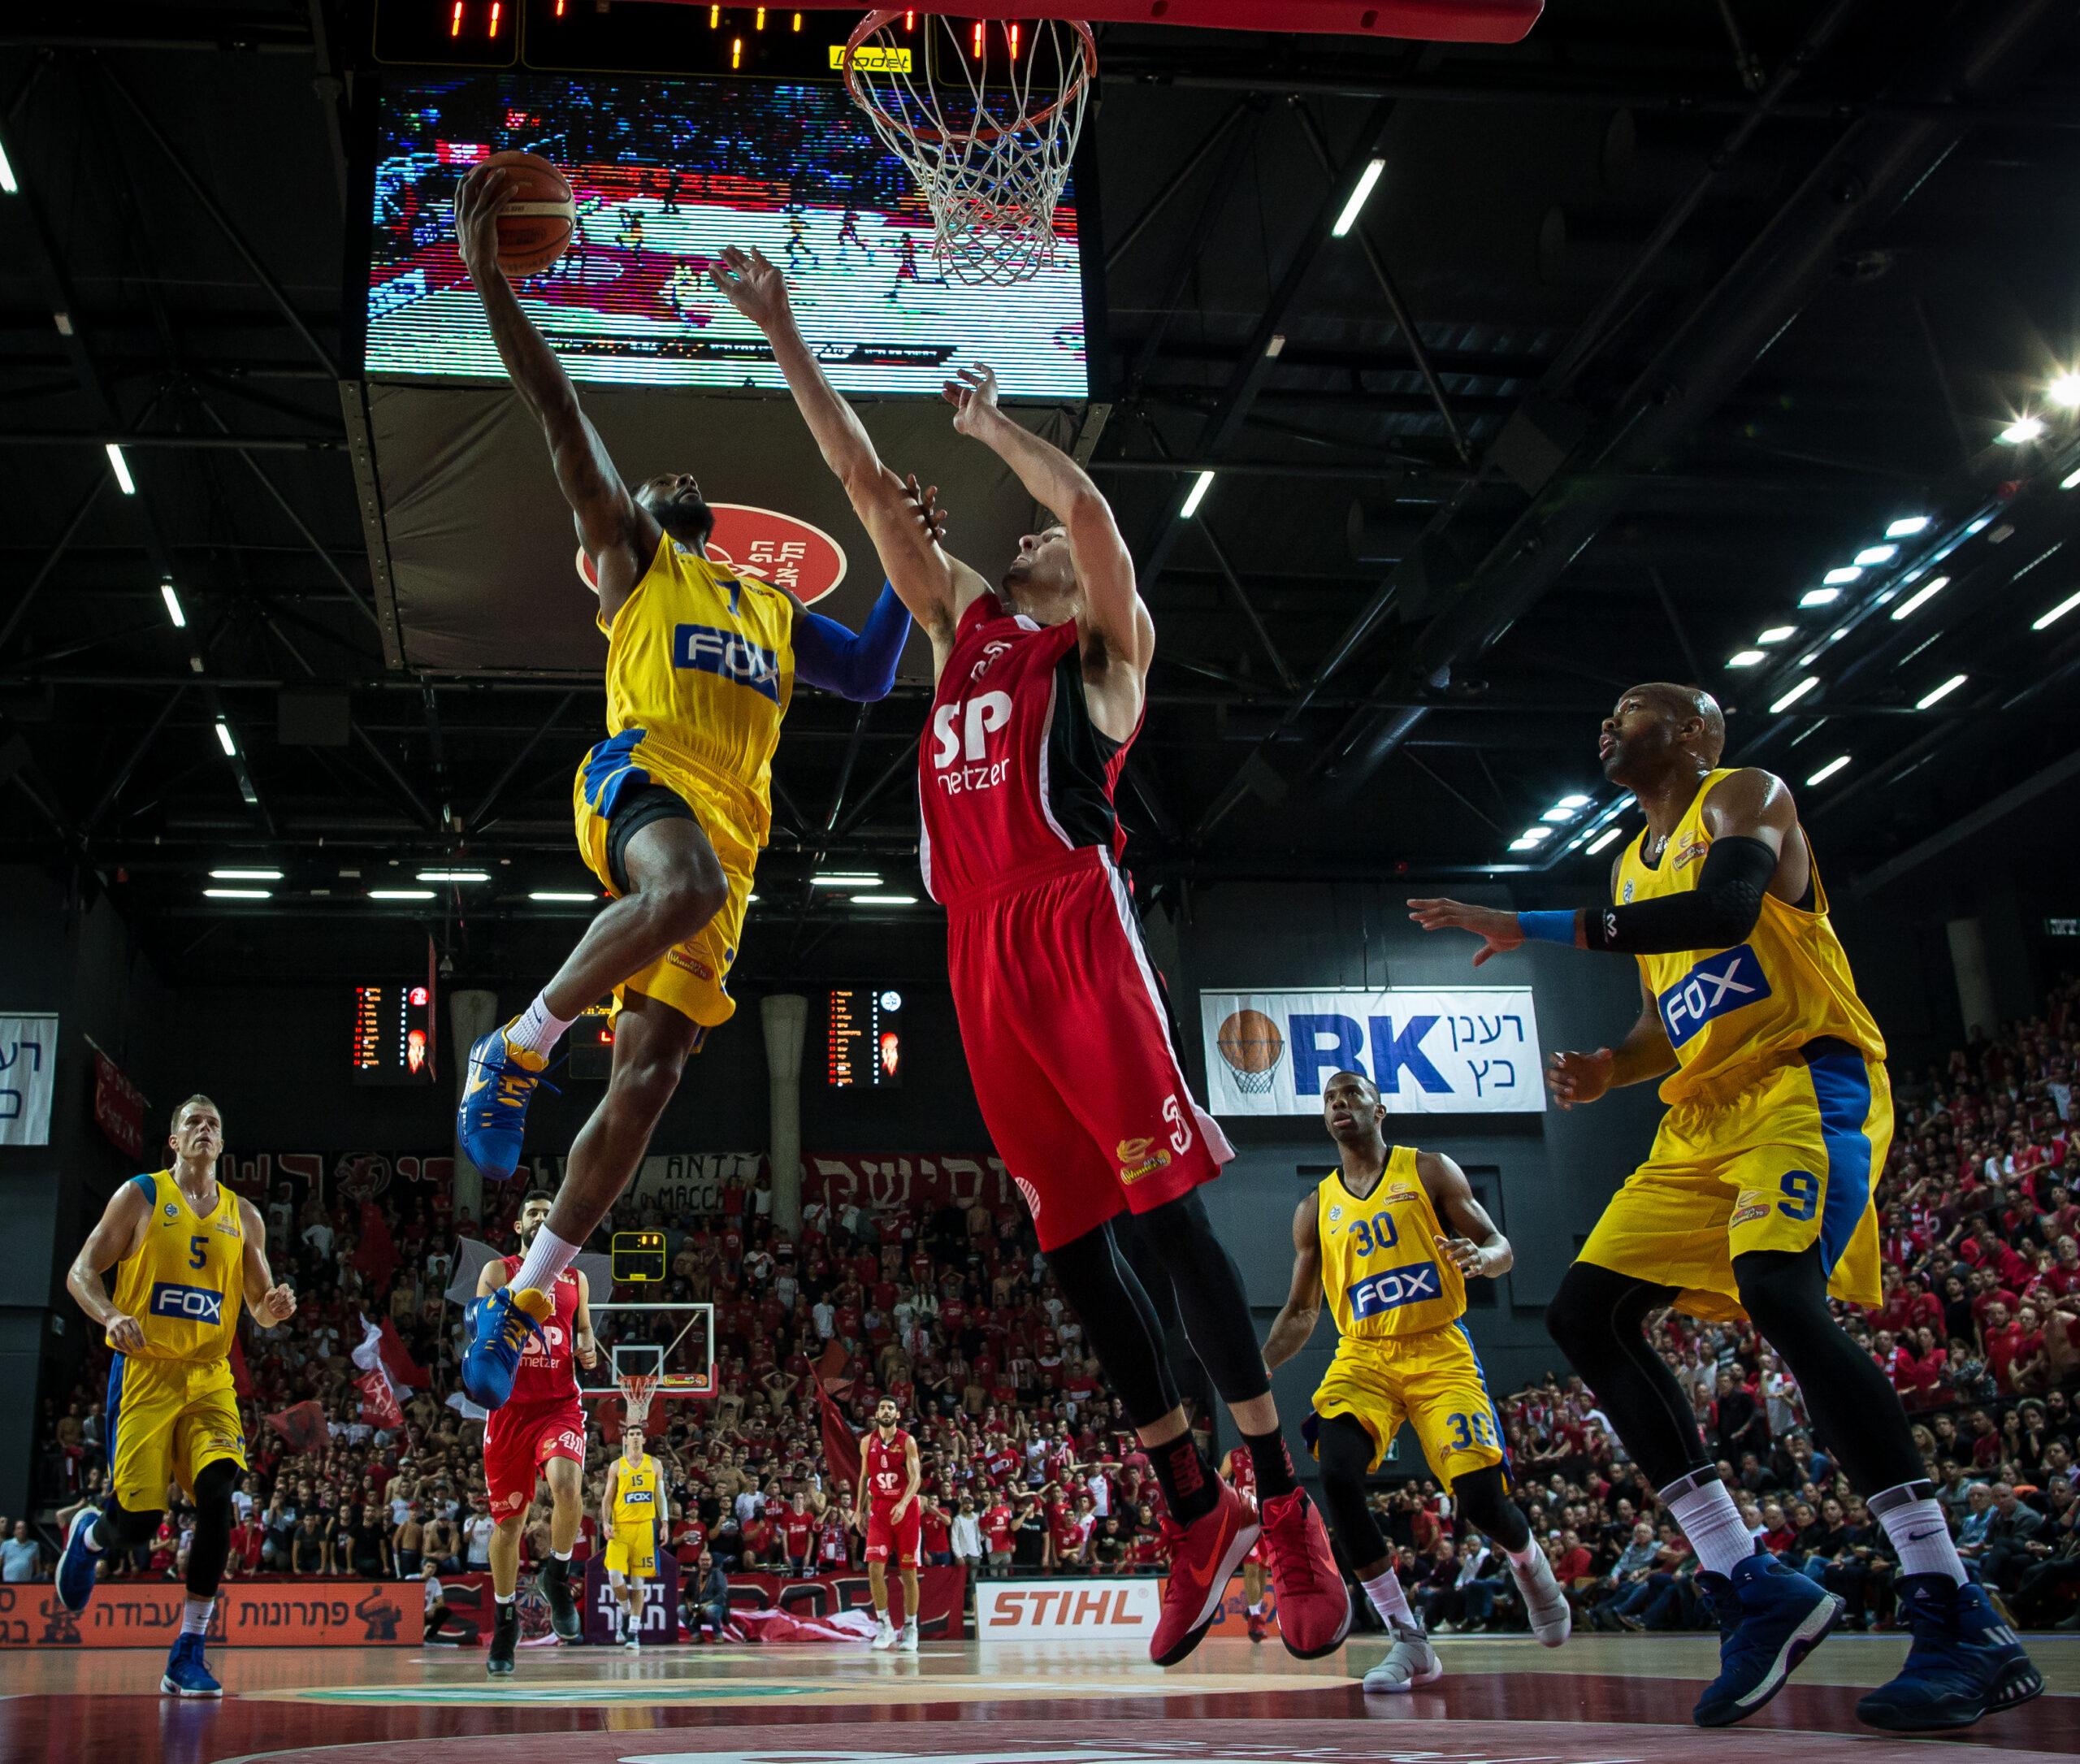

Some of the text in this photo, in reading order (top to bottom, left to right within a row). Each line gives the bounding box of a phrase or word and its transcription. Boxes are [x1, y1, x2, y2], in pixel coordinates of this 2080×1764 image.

[687, 633, 781, 705] FOX
[934, 691, 1012, 769] SP
[1666, 958, 1756, 1036] FOX
[1448, 1015, 1524, 1052] רענן
[1289, 1014, 1455, 1095] RK
[1467, 1060, 1515, 1098] כץ
[1162, 1094, 1193, 1155] 3
[1777, 1170, 1820, 1221] 9
[188, 1236, 210, 1269] 5
[1349, 1211, 1399, 1257] 30
[158, 1289, 222, 1320] FOX
[1356, 1269, 1434, 1313] FOX
[558, 1431, 583, 1456] 41
[1446, 1411, 1498, 1450] 30
[626, 1492, 651, 1503] FOX
[631, 1475, 644, 1486] 15
[876, 1472, 899, 1489] SP
[642, 1556, 653, 1568] 15
[94, 1601, 182, 1627] עבודה
[238, 1601, 349, 1627] פתרונות
[990, 1590, 1143, 1626] STIHL
